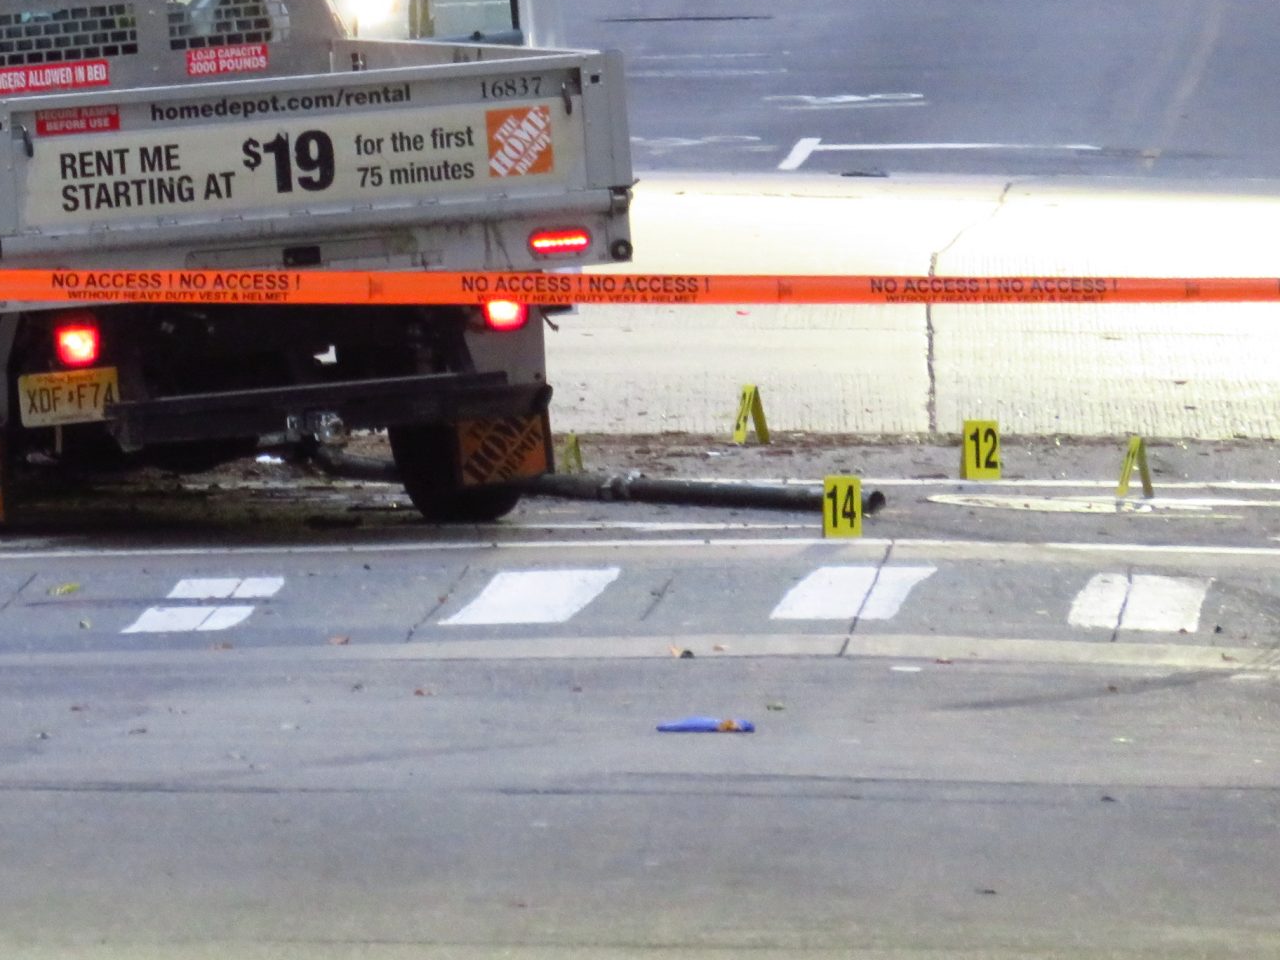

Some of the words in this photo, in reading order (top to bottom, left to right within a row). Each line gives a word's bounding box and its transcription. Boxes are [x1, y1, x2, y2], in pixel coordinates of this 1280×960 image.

[190, 61, 216, 74] 3000
[219, 56, 266, 71] POUNDS
[191, 50, 216, 61] LOAD
[218, 46, 262, 58] CAPACITY
[28, 68, 73, 87] ALLOWED
[74, 67, 85, 84] IN
[87, 65, 106, 82] BED
[480, 77, 542, 100] 16837
[151, 84, 411, 121] homedepot.com/rental
[46, 119, 89, 132] BEFORE
[90, 118, 110, 129] USE
[492, 115, 520, 143] THE
[355, 134, 384, 155] for
[390, 131, 424, 153] the
[430, 126, 475, 149] first
[488, 106, 552, 178] HOME
[60, 148, 129, 180] RENT
[140, 144, 181, 174] ME
[242, 130, 335, 194] $19
[514, 132, 552, 177] DEPOT
[357, 166, 383, 188] 75
[390, 161, 475, 185] minutes
[62, 176, 195, 213] STARTING
[204, 171, 236, 201] AT
[52, 273, 79, 288] NO
[86, 274, 161, 289] ACCESS
[180, 274, 206, 289] NO
[213, 275, 288, 290] ACCESS
[462, 277, 489, 291] NO
[496, 277, 571, 292] ACCESS
[589, 277, 616, 292] NO
[622, 278, 699, 292] ACCESS
[871, 280, 898, 293] NO
[904, 280, 979, 293] ACCESS
[997, 280, 1024, 293] NO
[1031, 280, 1107, 293] ACCESS
[68, 290, 120, 300] WITHOUT
[124, 291, 161, 300] HEAVY
[166, 291, 195, 301] DUTY
[199, 291, 228, 301] VEST
[243, 292, 288, 301] HELMET
[969, 428, 999, 469] 12
[827, 484, 855, 529] 14
